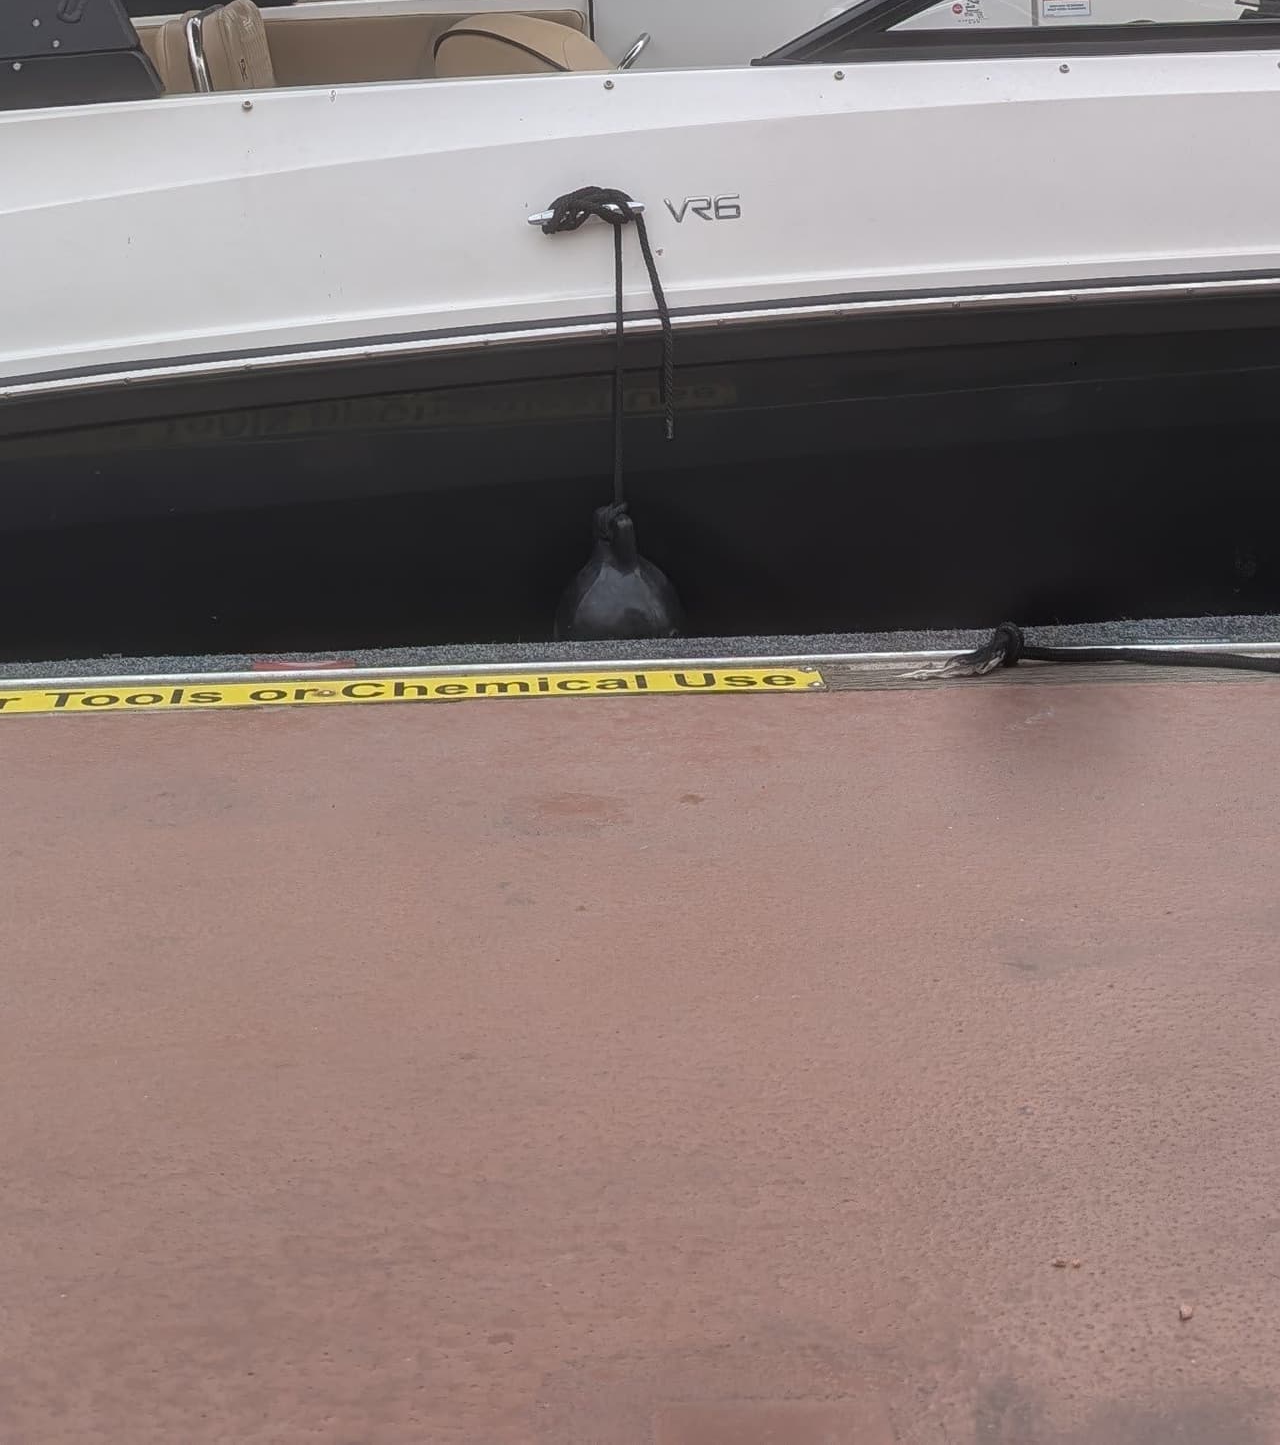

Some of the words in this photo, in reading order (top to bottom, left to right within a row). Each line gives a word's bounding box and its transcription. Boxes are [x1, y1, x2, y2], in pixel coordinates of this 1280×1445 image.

[663, 193, 741, 223] VR6
[45, 688, 223, 709] Tools
[249, 688, 319, 702] or
[341, 674, 648, 699] Chemical
[674, 671, 797, 689] Use
